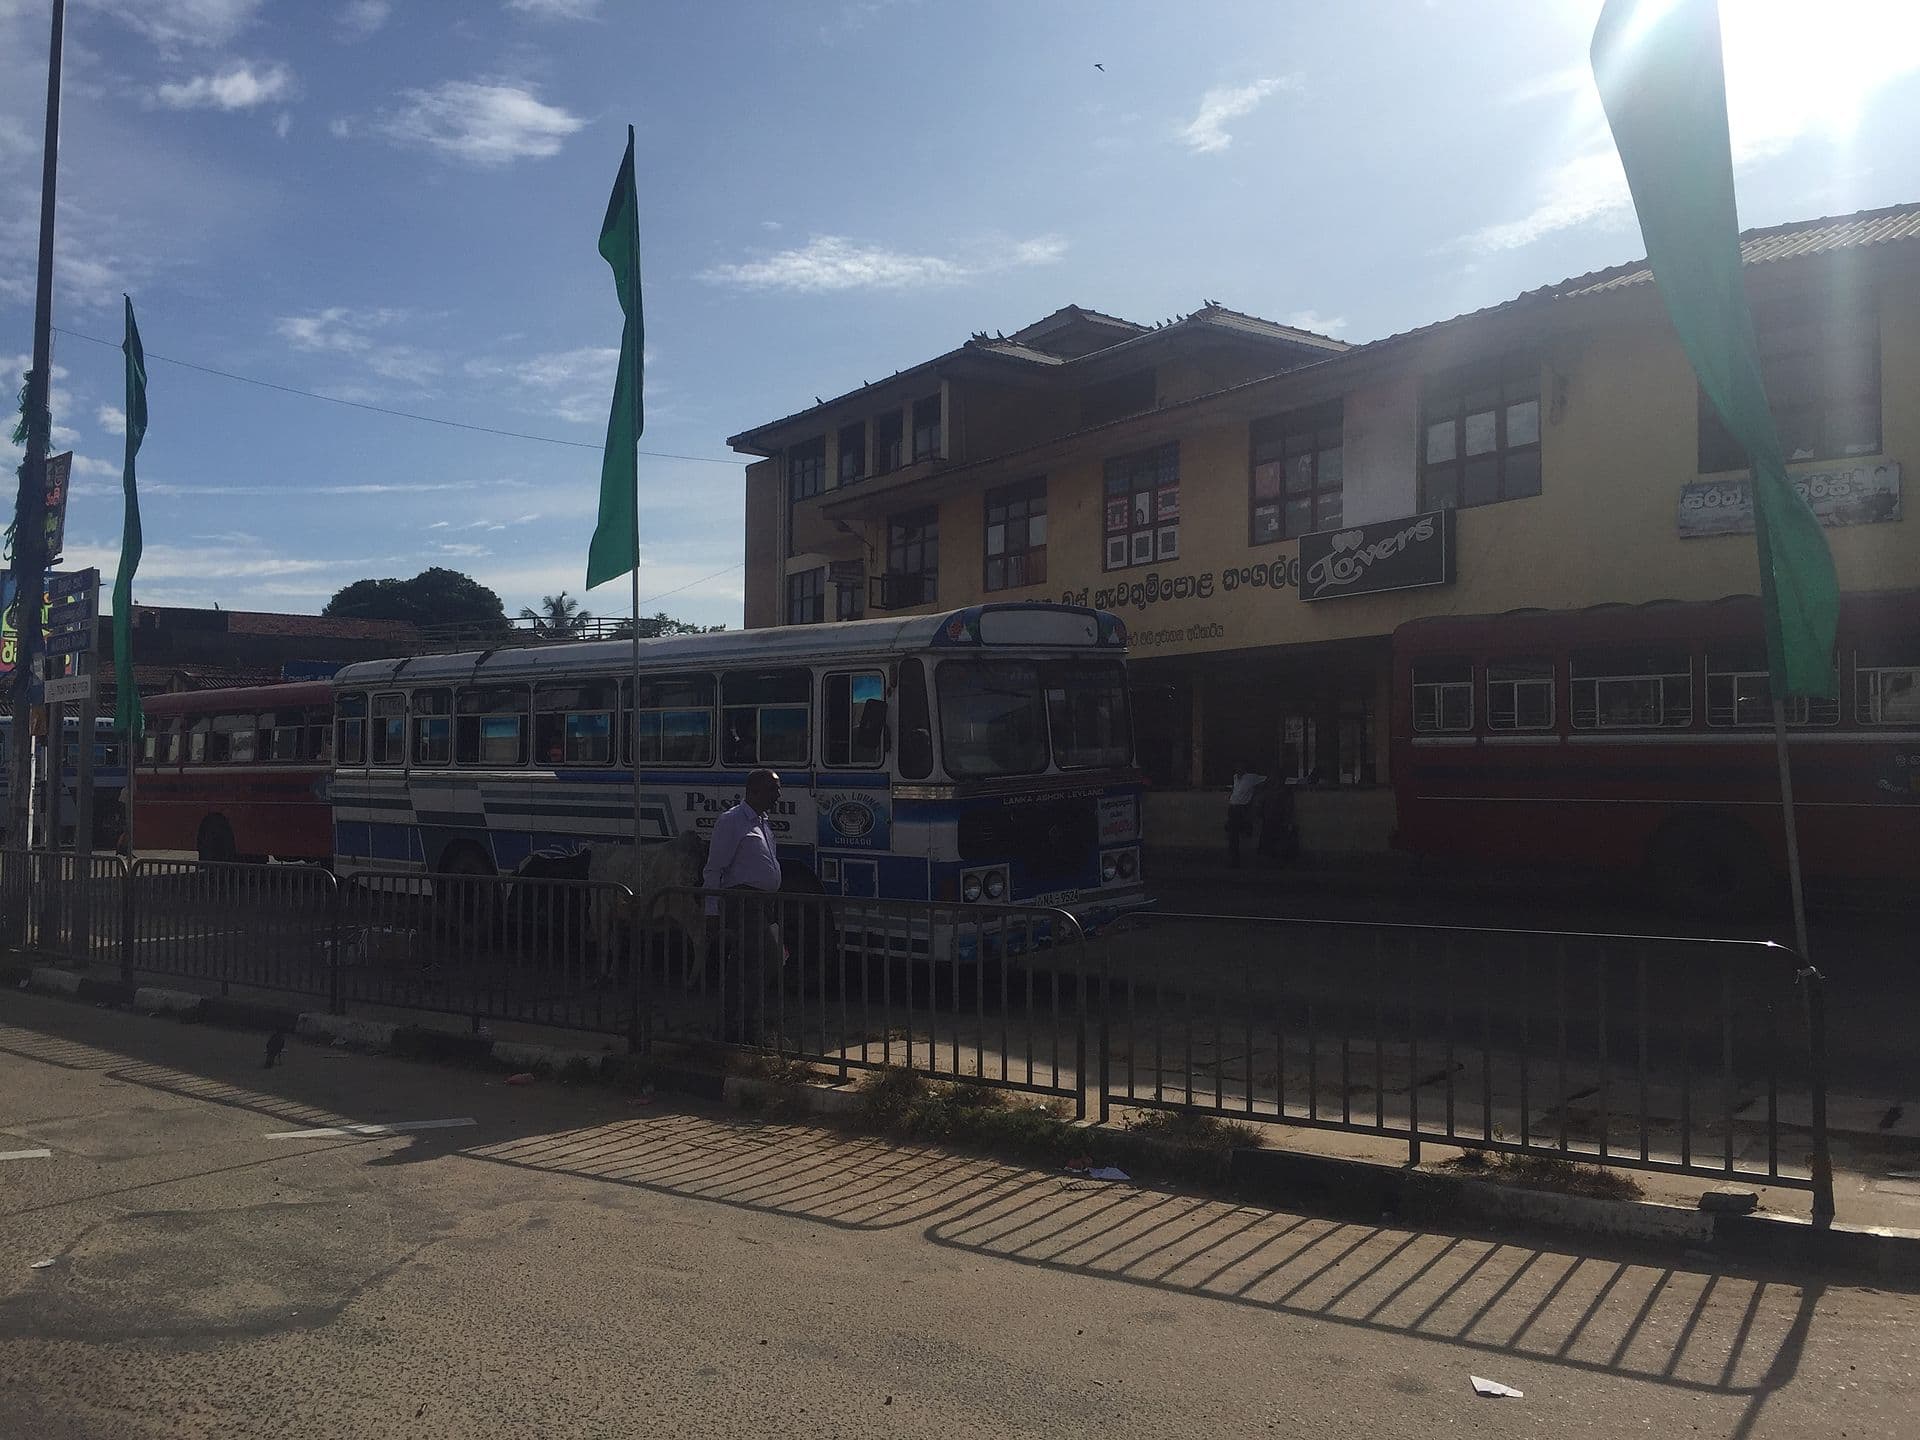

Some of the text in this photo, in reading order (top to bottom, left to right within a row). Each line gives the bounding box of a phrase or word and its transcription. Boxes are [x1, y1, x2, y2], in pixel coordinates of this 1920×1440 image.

[1306, 517, 1434, 597] Lovers
[1036, 793, 1065, 803] ASHOK
[1068, 788, 1104, 799] LEYLAND
